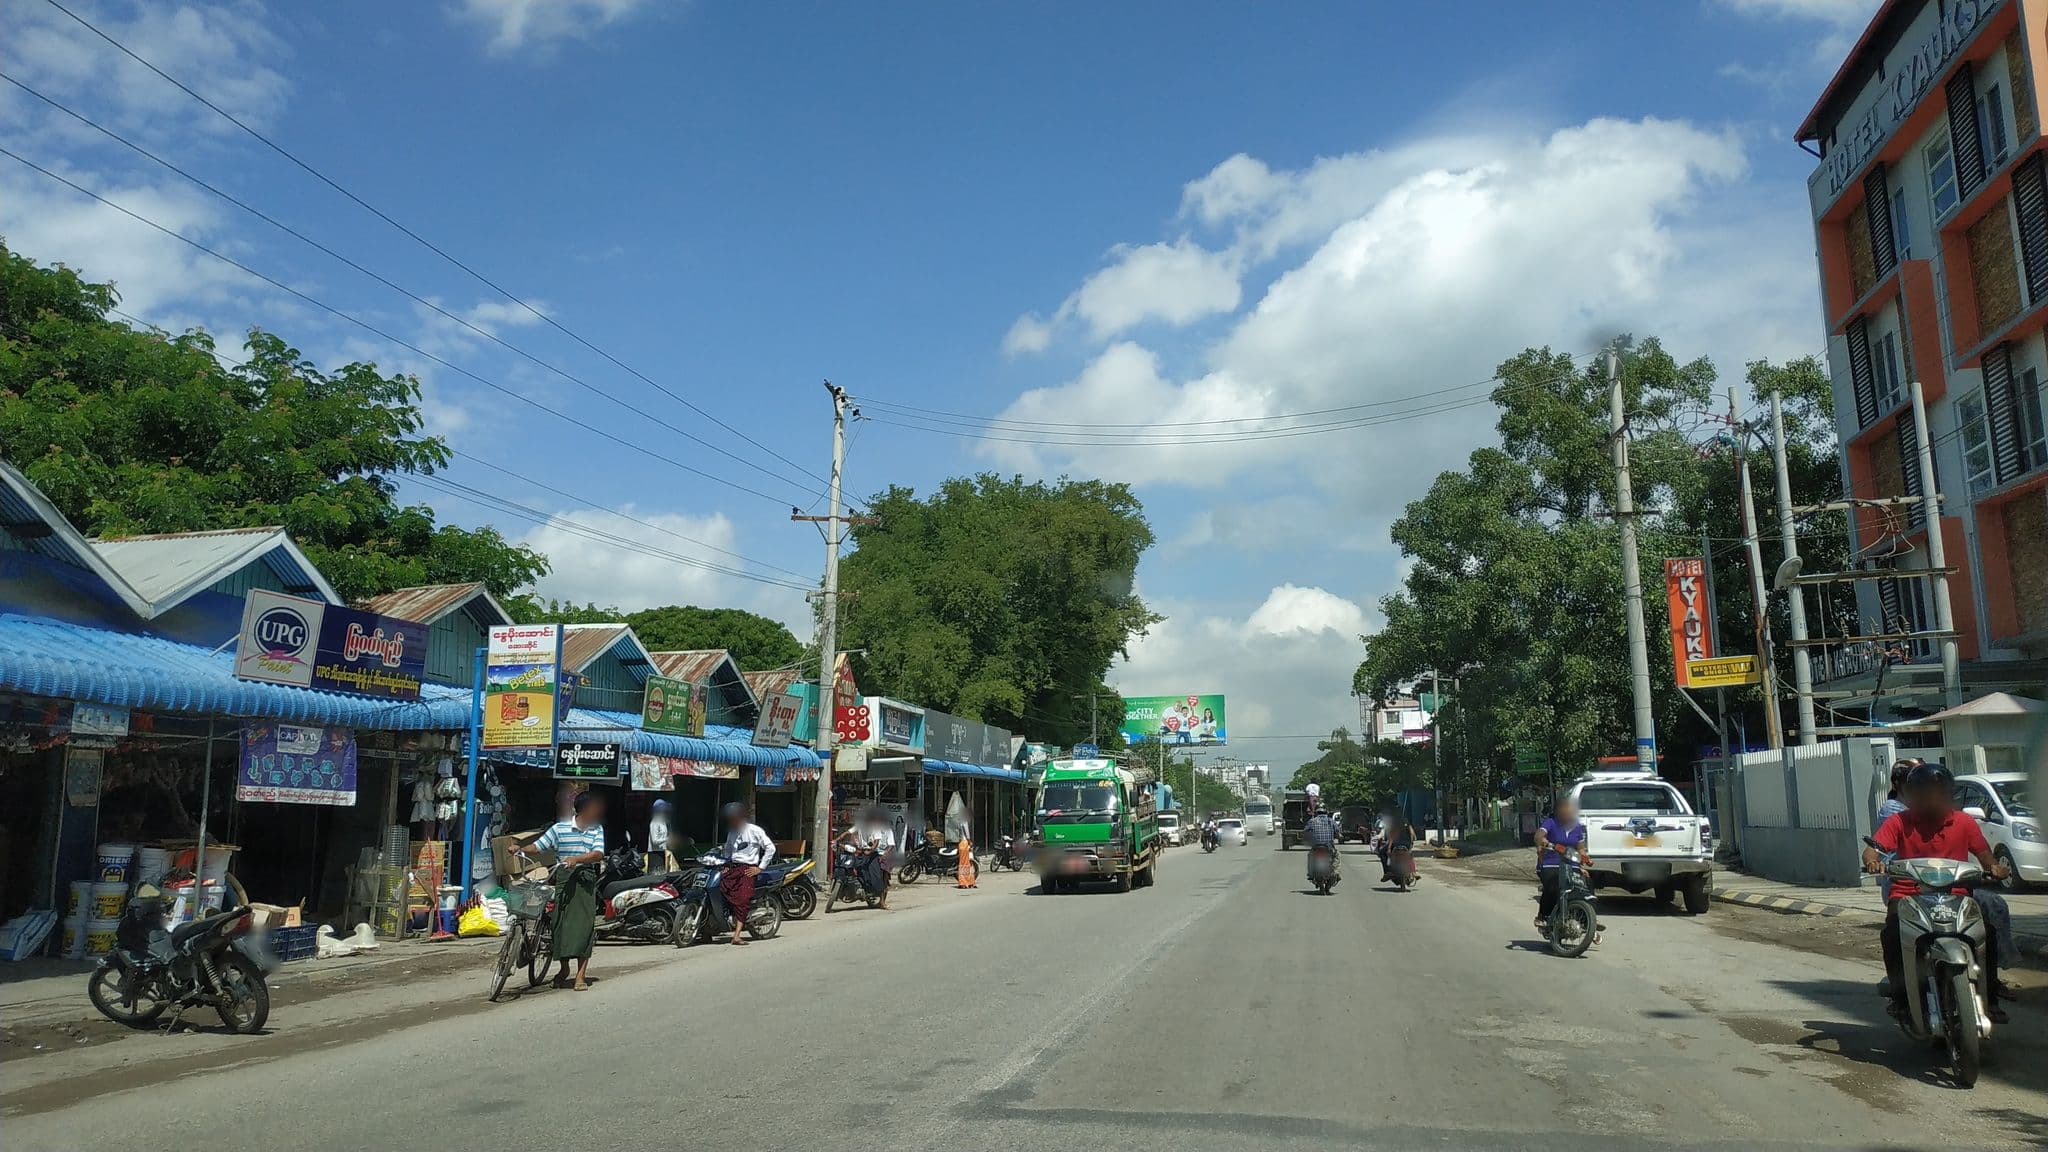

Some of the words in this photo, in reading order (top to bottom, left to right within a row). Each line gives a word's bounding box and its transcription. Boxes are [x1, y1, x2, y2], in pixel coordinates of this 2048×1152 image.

[1826, 107, 1885, 196] HOTEL
[1671, 559, 1703, 576] HOTEL
[261, 620, 304, 647] UPG
[315, 664, 331, 679] UPG
[1692, 663, 1727, 673] WESTERN
[1703, 668, 1728, 676] UNION
[1136, 707, 1154, 715] CITY
